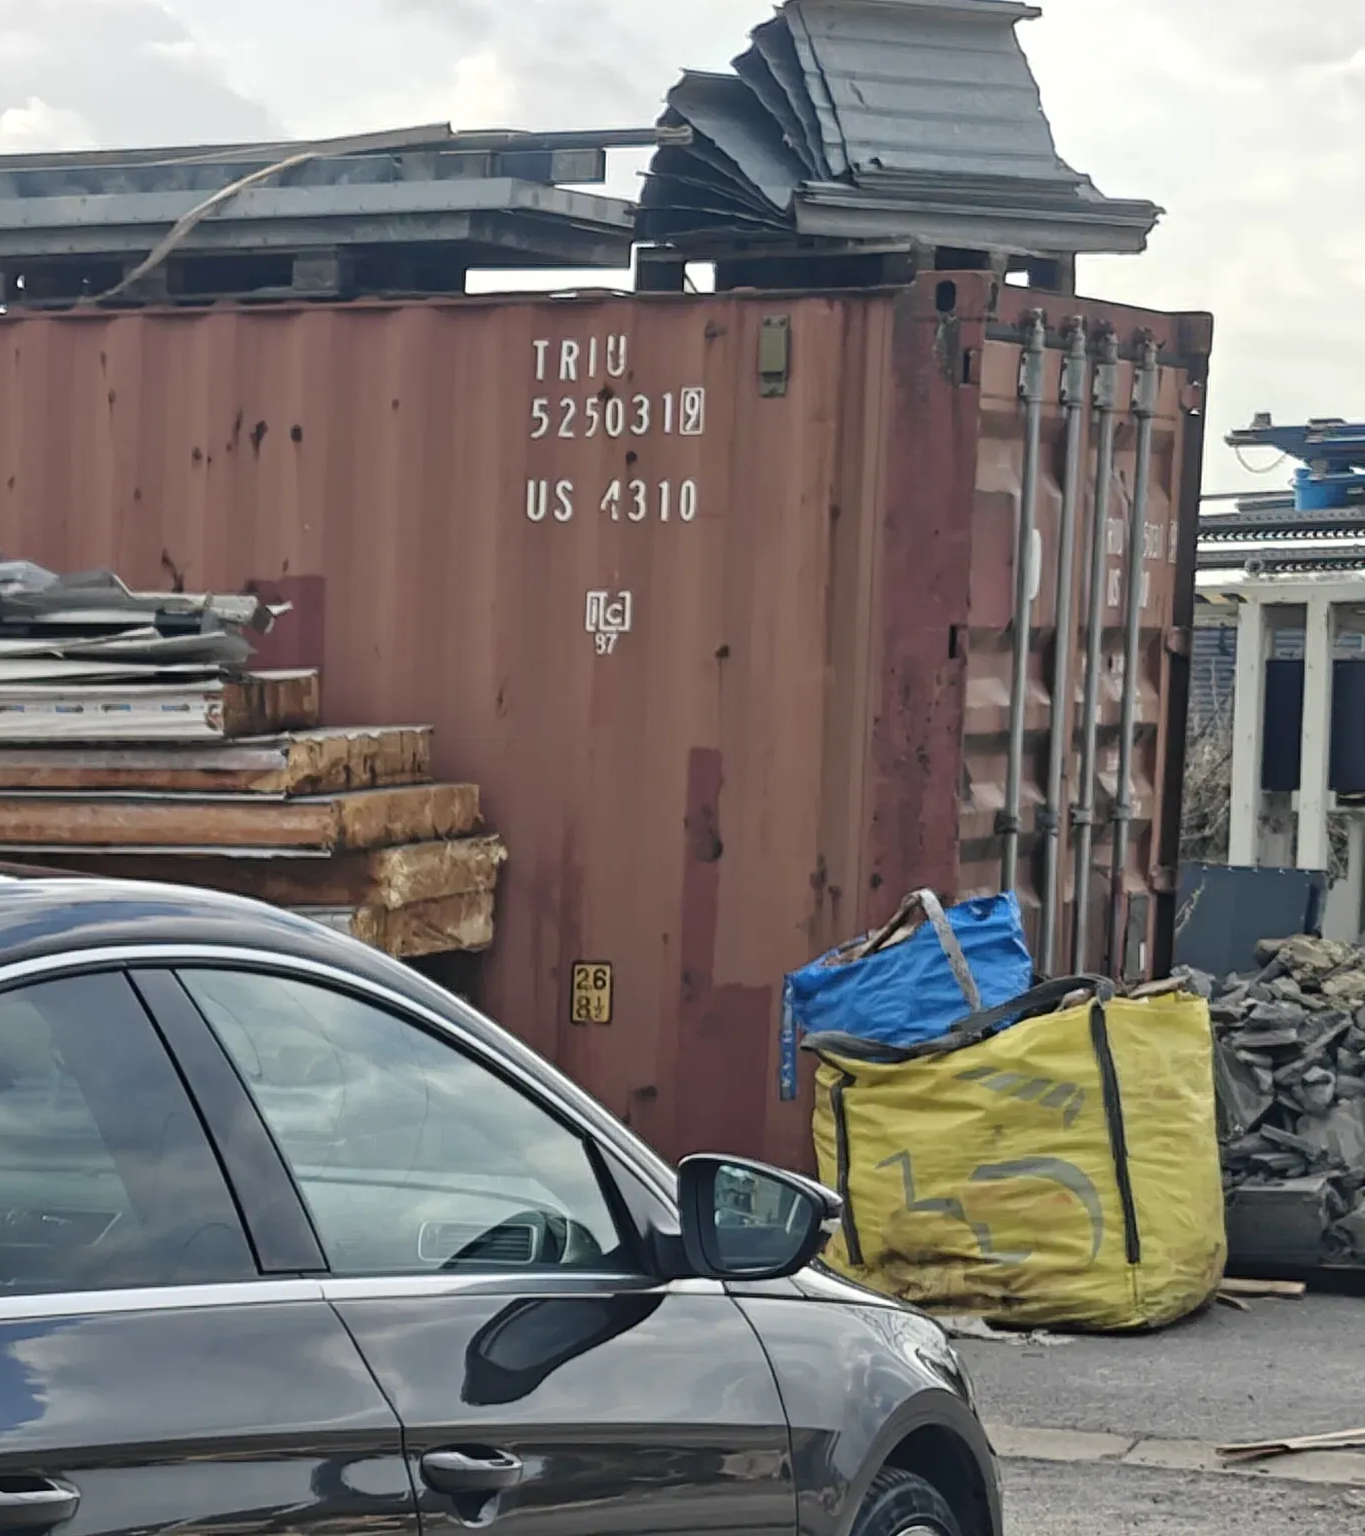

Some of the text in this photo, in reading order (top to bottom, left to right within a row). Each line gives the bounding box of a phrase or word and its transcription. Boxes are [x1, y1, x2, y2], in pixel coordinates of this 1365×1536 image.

[532, 335, 627, 381] TRIU
[527, 479, 697, 522] US 4310
